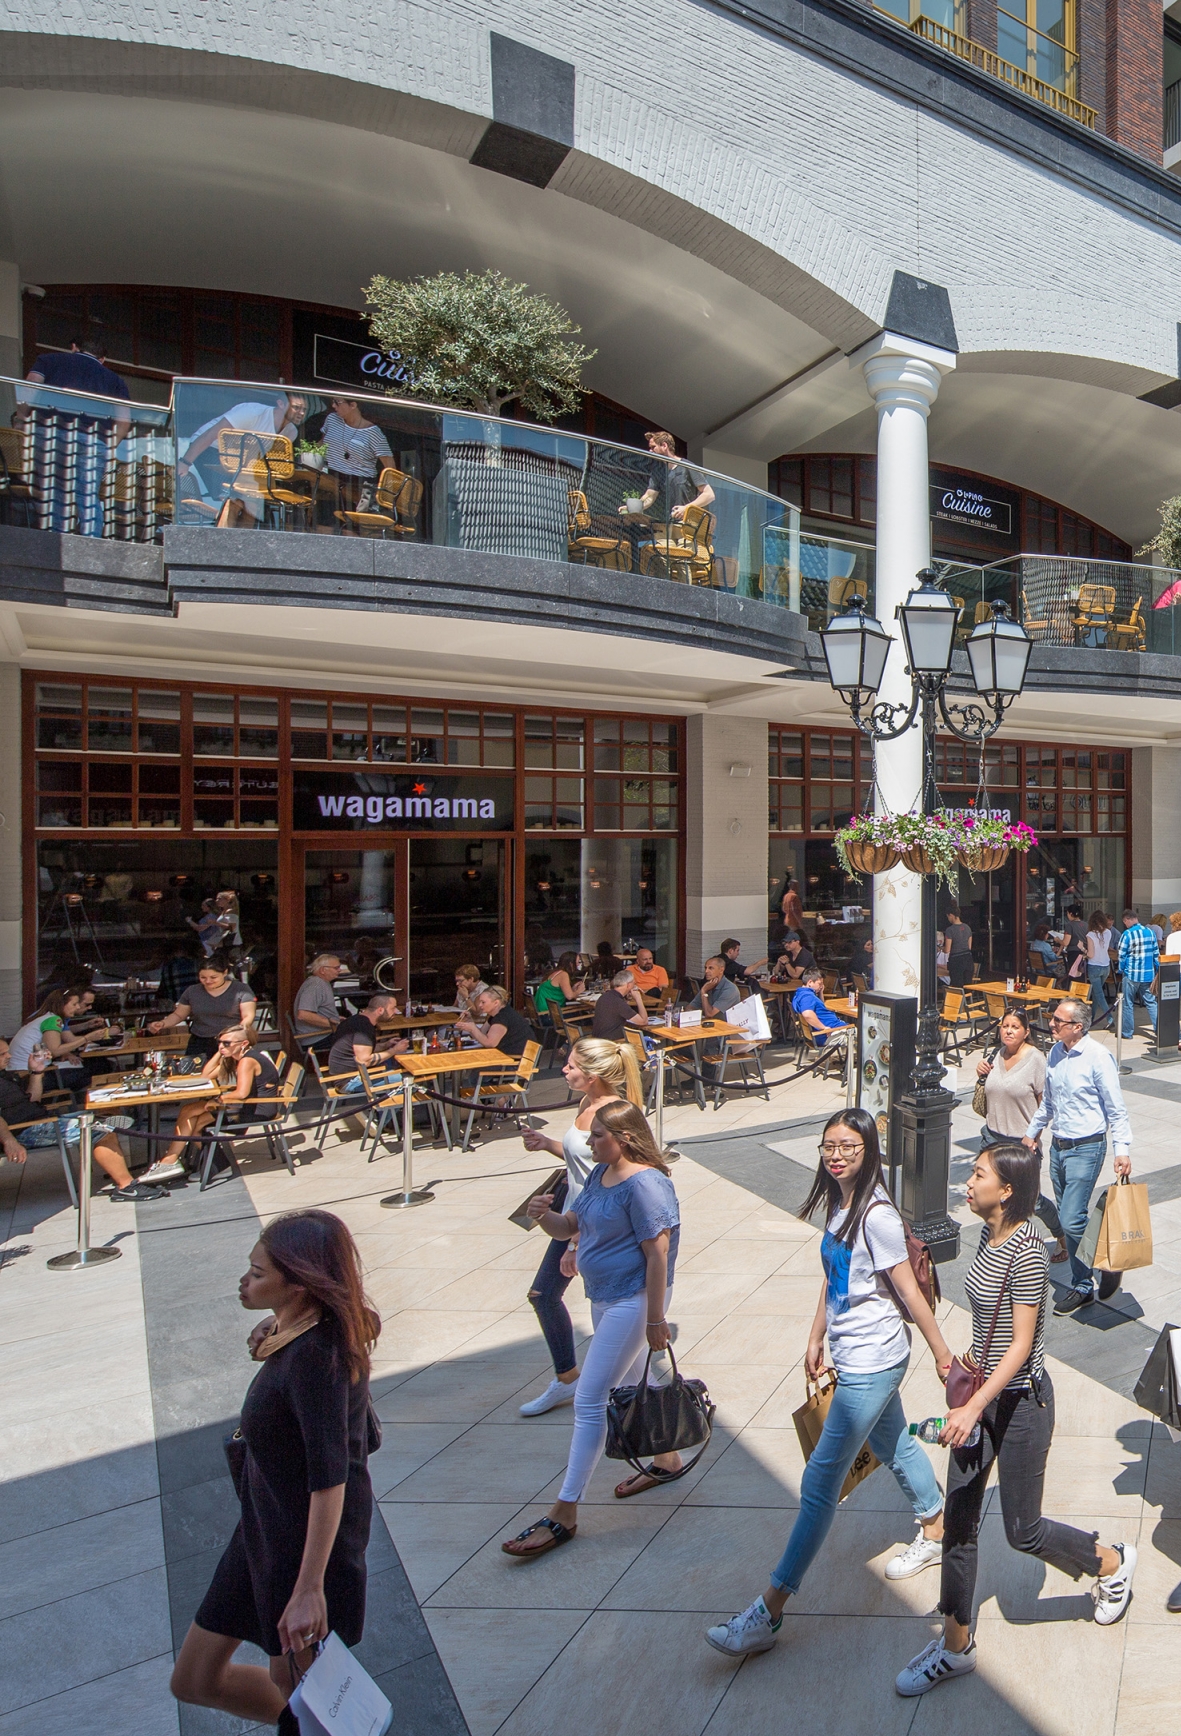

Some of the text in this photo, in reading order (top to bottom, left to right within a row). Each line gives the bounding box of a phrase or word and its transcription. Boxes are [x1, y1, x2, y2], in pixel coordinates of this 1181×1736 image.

[363, 380, 385, 391] PASTA
[942, 492, 992, 519] Cuisine
[317, 795, 495, 824] wagamama
[328, 1675, 353, 1718] Calvin Klein
